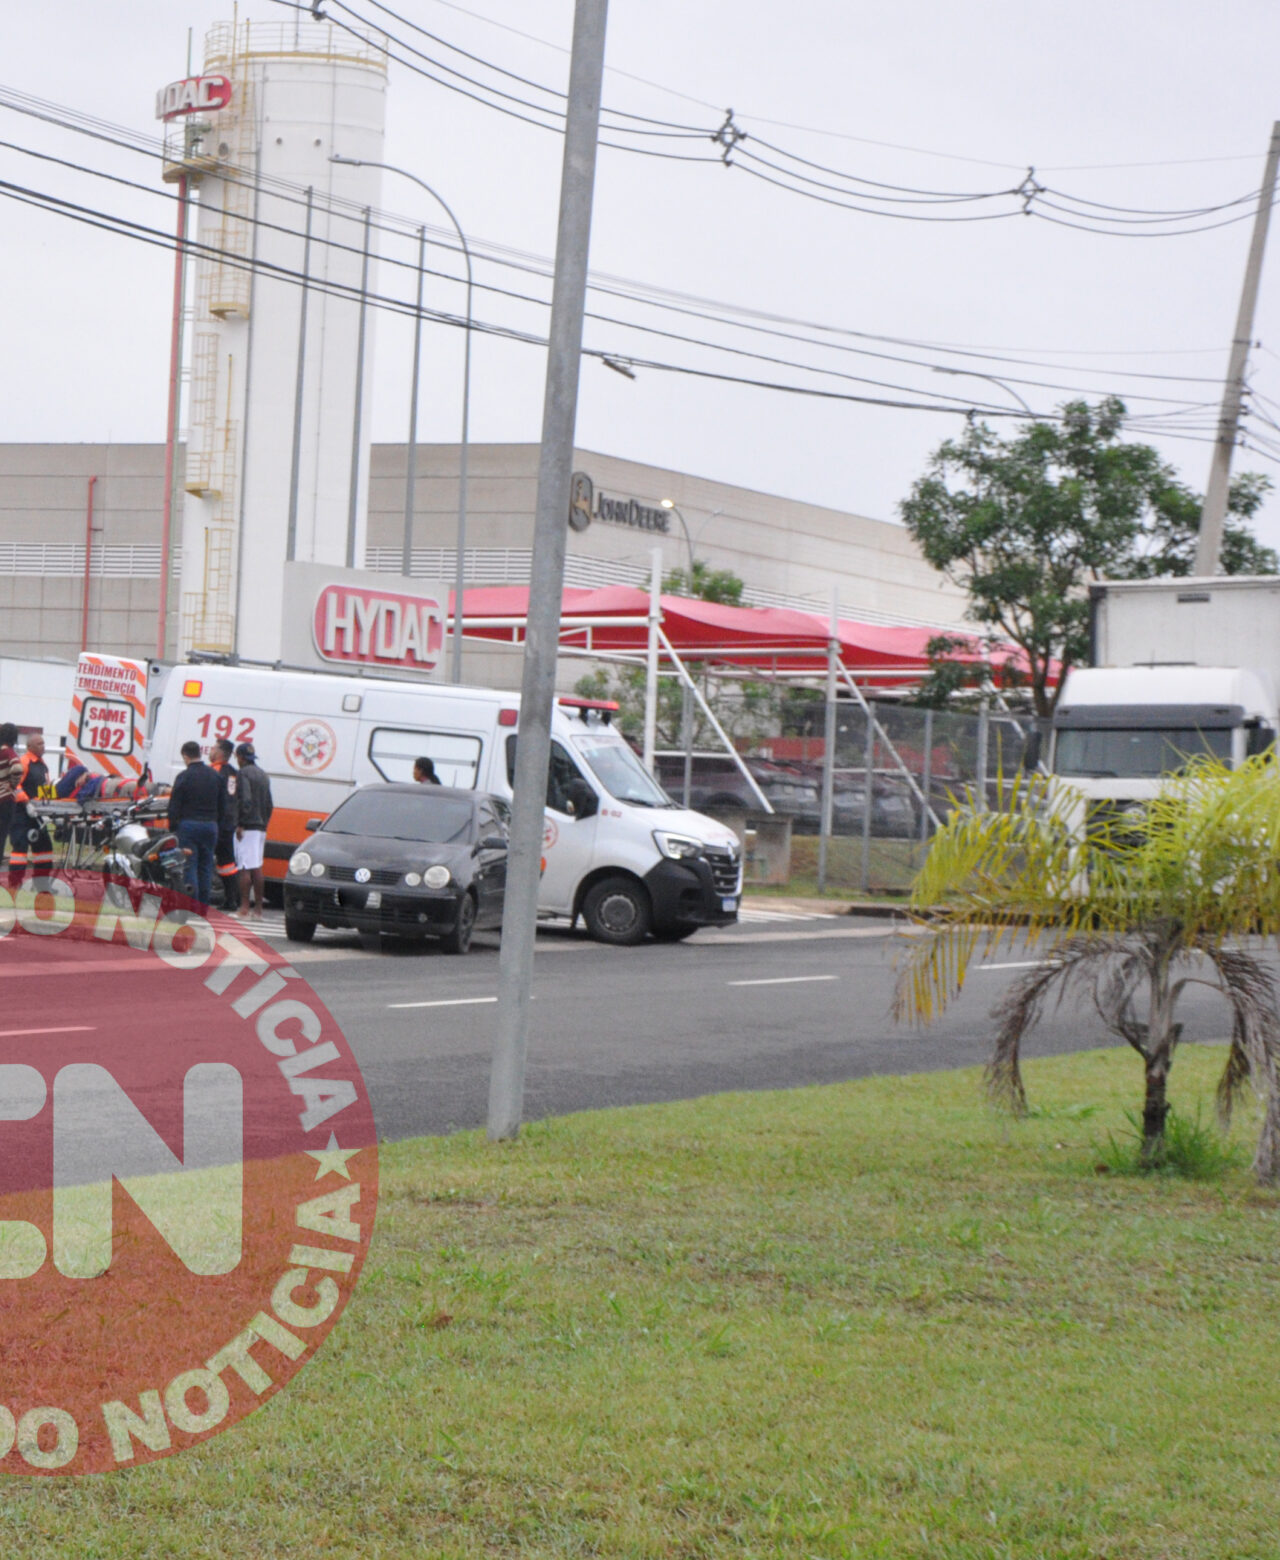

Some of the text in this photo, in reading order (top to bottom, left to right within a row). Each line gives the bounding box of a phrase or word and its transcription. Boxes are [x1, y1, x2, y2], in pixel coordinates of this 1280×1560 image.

[156, 77, 225, 119] DAC
[323, 591, 443, 664] HYDAC
[89, 706, 127, 724] SAME
[197, 713, 257, 744] 192
[89, 725, 126, 751] 192
